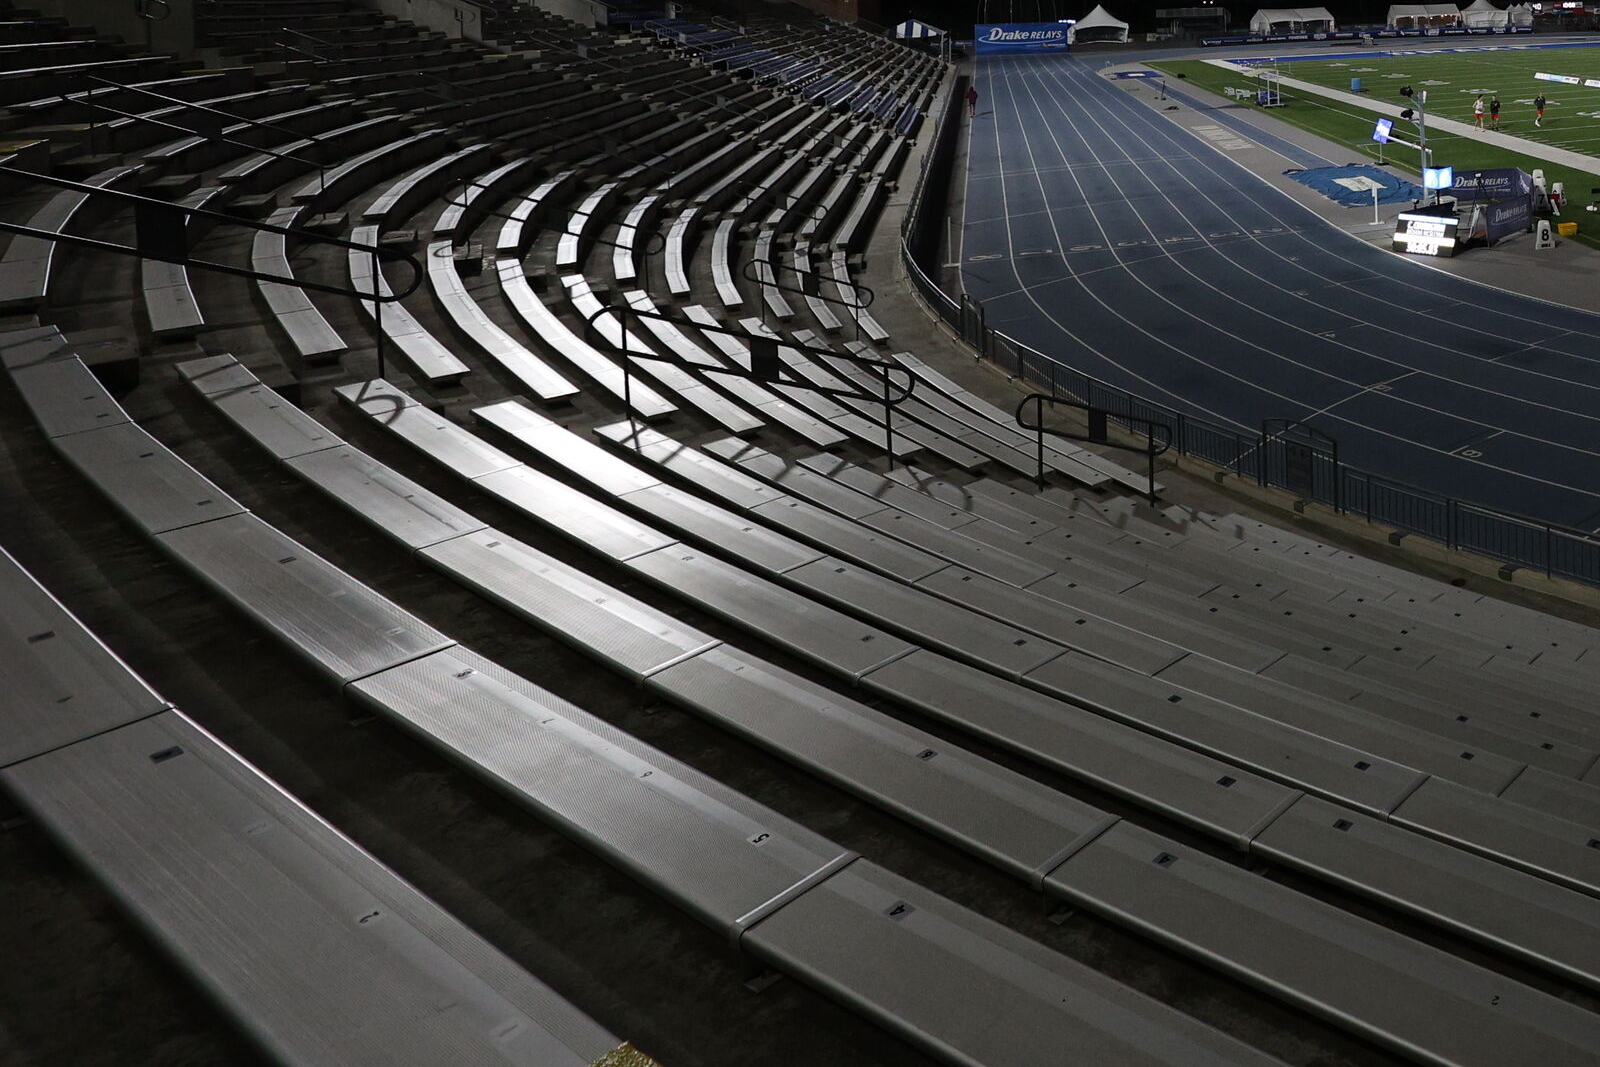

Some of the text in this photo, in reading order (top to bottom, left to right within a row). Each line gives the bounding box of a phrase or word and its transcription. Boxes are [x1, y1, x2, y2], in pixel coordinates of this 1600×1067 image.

[988, 27, 1062, 41] Drake RELAYS
[1484, 177, 1509, 185] RELAYS
[1538, 194, 1545, 204] 7
[1494, 204, 1528, 223] Drake RELAYS
[1541, 228, 1549, 241] 8
